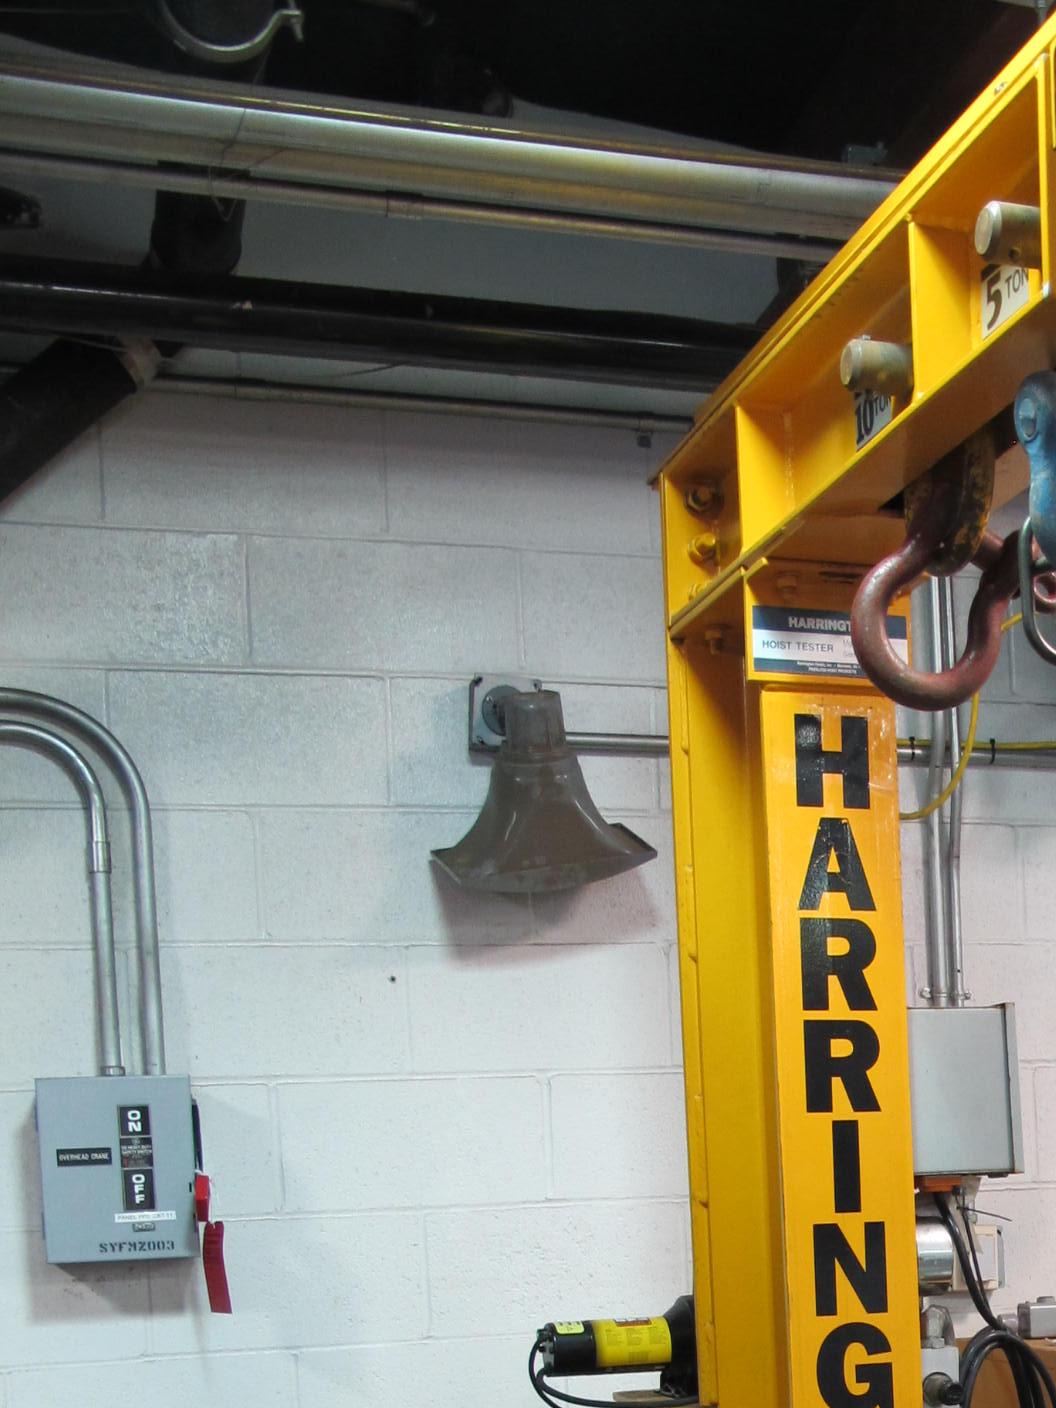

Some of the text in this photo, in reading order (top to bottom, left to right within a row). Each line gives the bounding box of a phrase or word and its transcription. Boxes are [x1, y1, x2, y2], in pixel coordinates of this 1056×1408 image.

[986, 267, 1029, 330] 5 TON
[788, 616, 852, 633] HARRINGT
[762, 640, 792, 650] HOIST
[795, 642, 834, 653] TESTER
[127, 1110, 142, 1132] ON
[90, 1152, 110, 1160] CRANE
[132, 1174, 146, 1204] OFF
